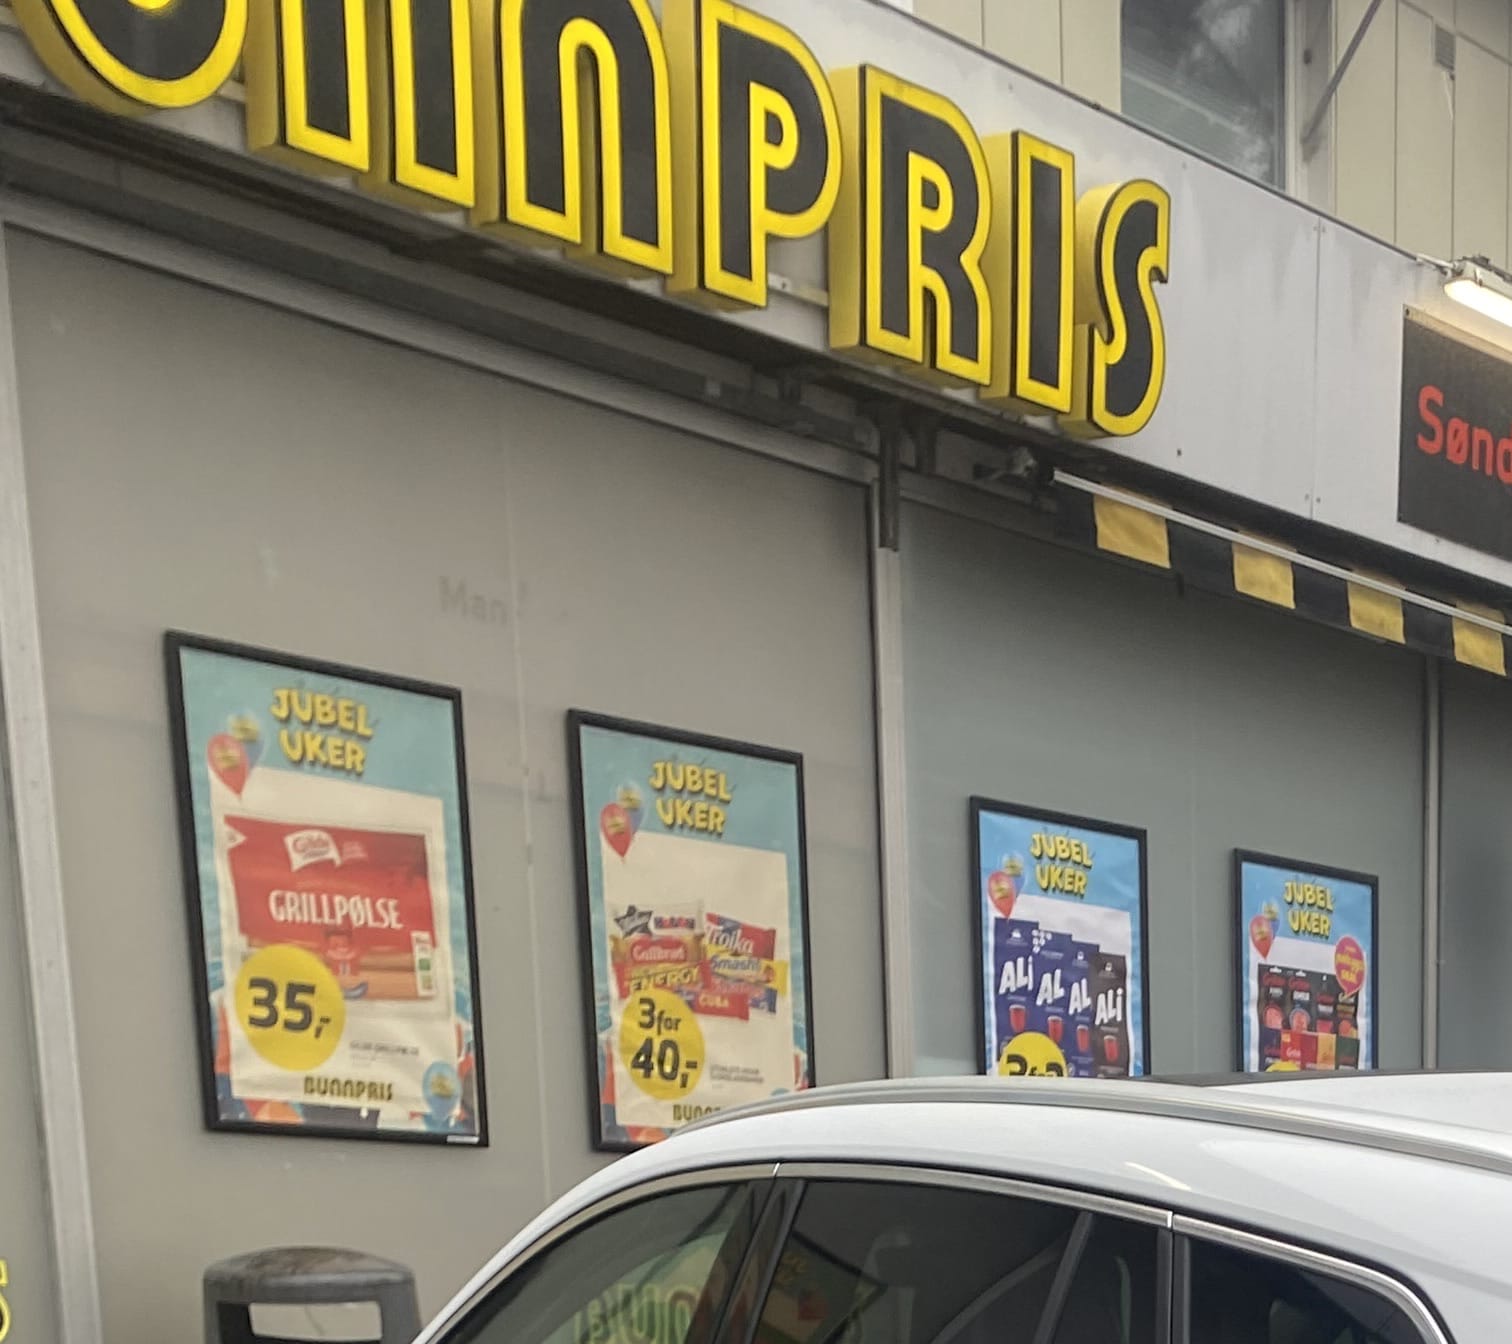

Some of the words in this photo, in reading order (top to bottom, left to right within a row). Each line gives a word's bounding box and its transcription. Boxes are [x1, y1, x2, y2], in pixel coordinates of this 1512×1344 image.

[269, 688, 375, 738] JUBEL
[278, 728, 368, 776] UKER
[649, 761, 733, 803] JUBEL
[655, 797, 727, 838] UKER
[1029, 832, 1093, 869] JUBEL
[1036, 863, 1089, 900] UKER
[1283, 881, 1334, 913] JUBEL
[268, 889, 405, 930] GRILLPØLSE
[1287, 908, 1332, 940] UKER
[638, 997, 656, 1030] 3
[655, 1009, 683, 1036] for
[304, 1074, 394, 1102] BUNNPRIS
